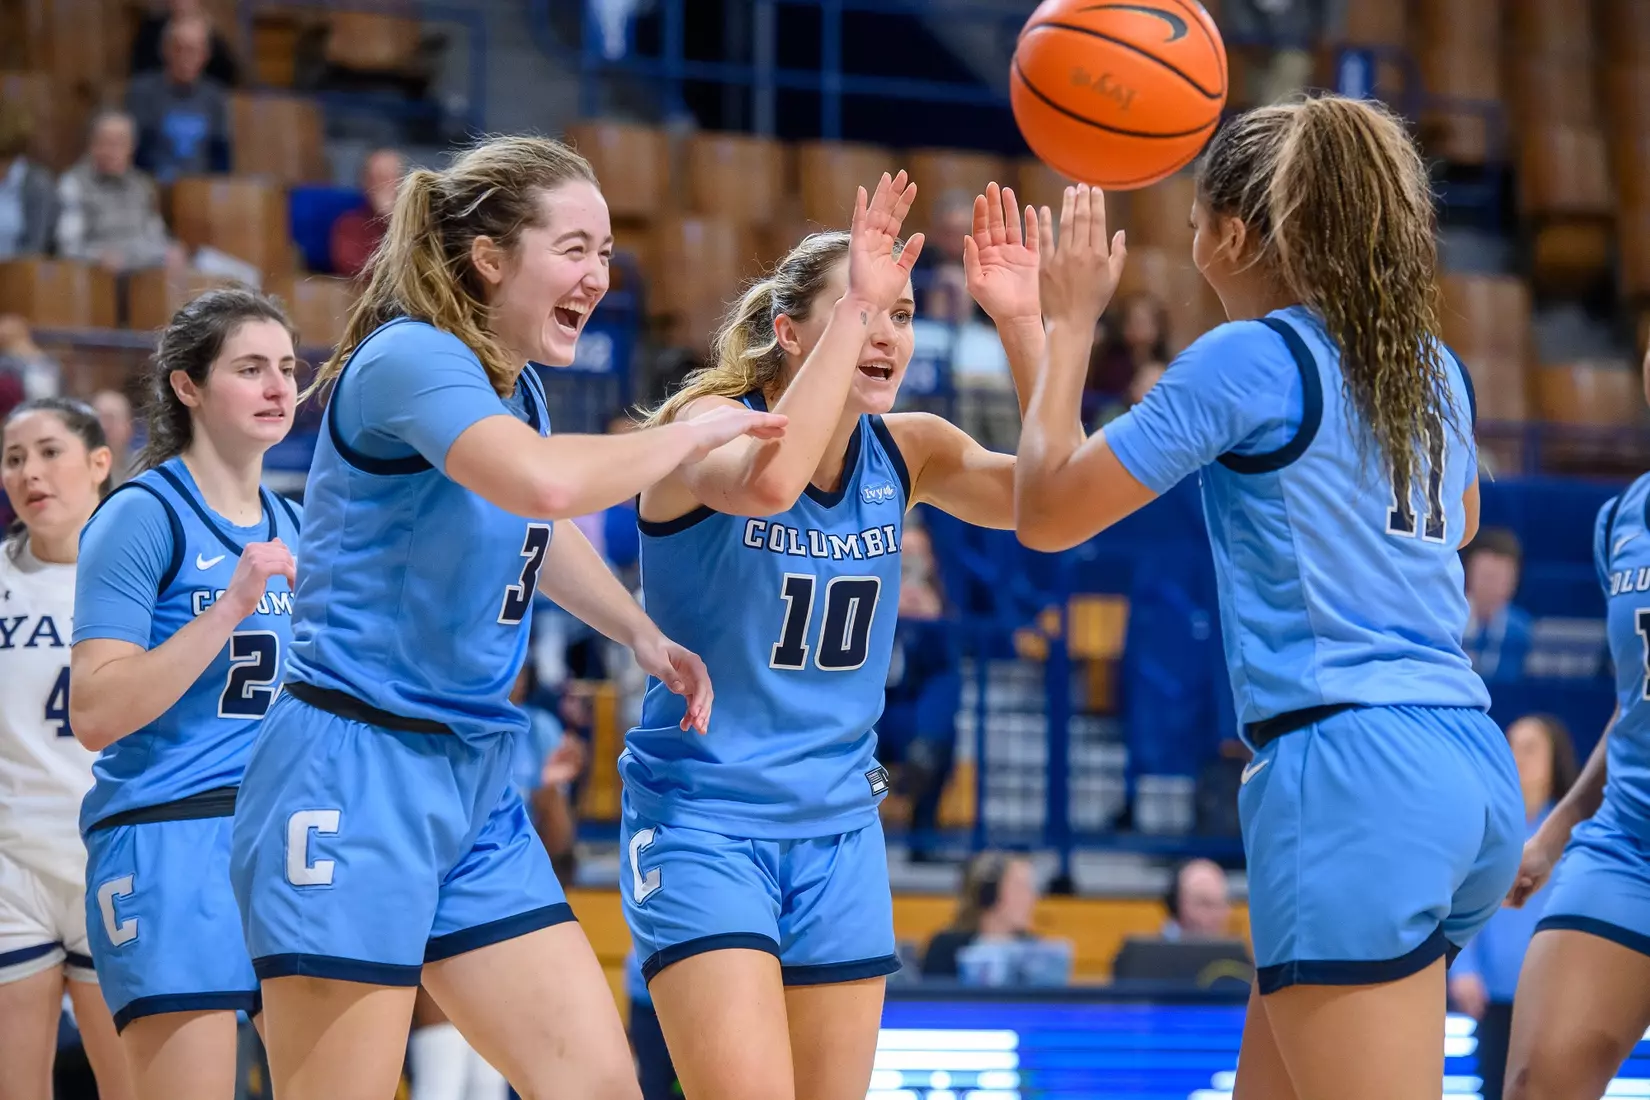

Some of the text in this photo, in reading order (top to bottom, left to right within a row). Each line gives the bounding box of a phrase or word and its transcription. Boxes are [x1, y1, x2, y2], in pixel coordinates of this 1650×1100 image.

[497, 522, 551, 625] 3
[743, 518, 903, 561] COLUMBI
[192, 589, 295, 617] CUM
[1608, 567, 1650, 596] OLU
[0, 615, 73, 649] YA
[769, 572, 882, 671] 10
[286, 809, 341, 887] C
[628, 827, 662, 905] C
[97, 873, 138, 947] C
